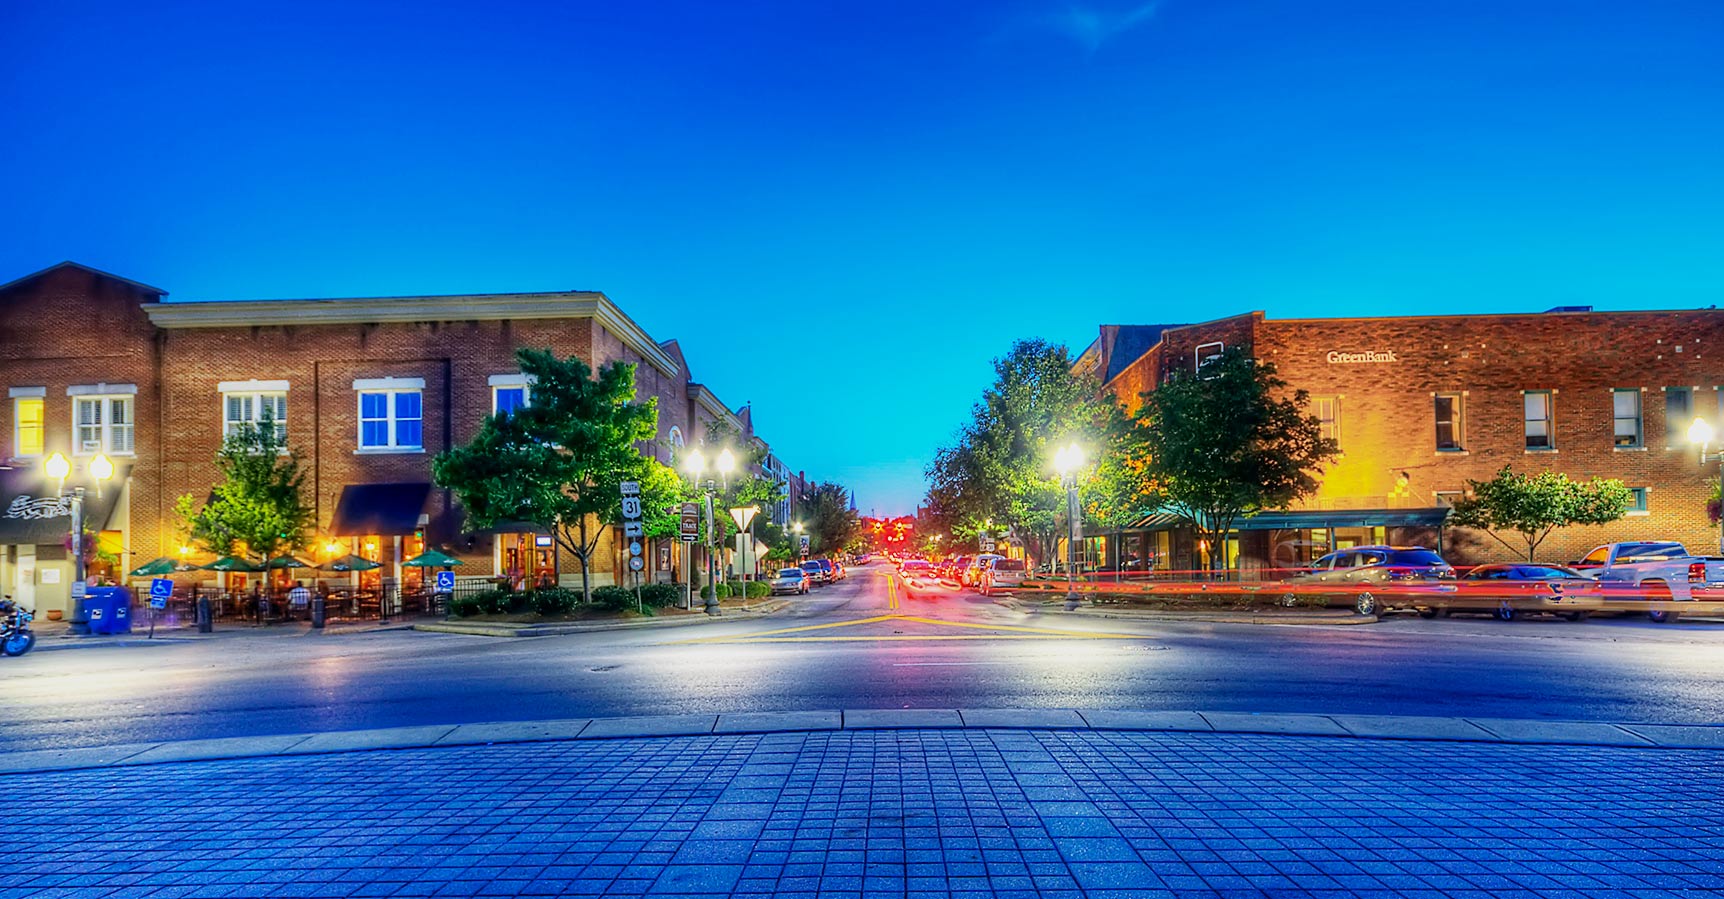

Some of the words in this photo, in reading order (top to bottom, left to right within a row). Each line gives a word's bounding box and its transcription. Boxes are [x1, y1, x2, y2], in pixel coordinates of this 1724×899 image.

[1327, 350, 1397, 364] GreenBank
[621, 483, 638, 492] SOUTH
[626, 501, 638, 514] 31
